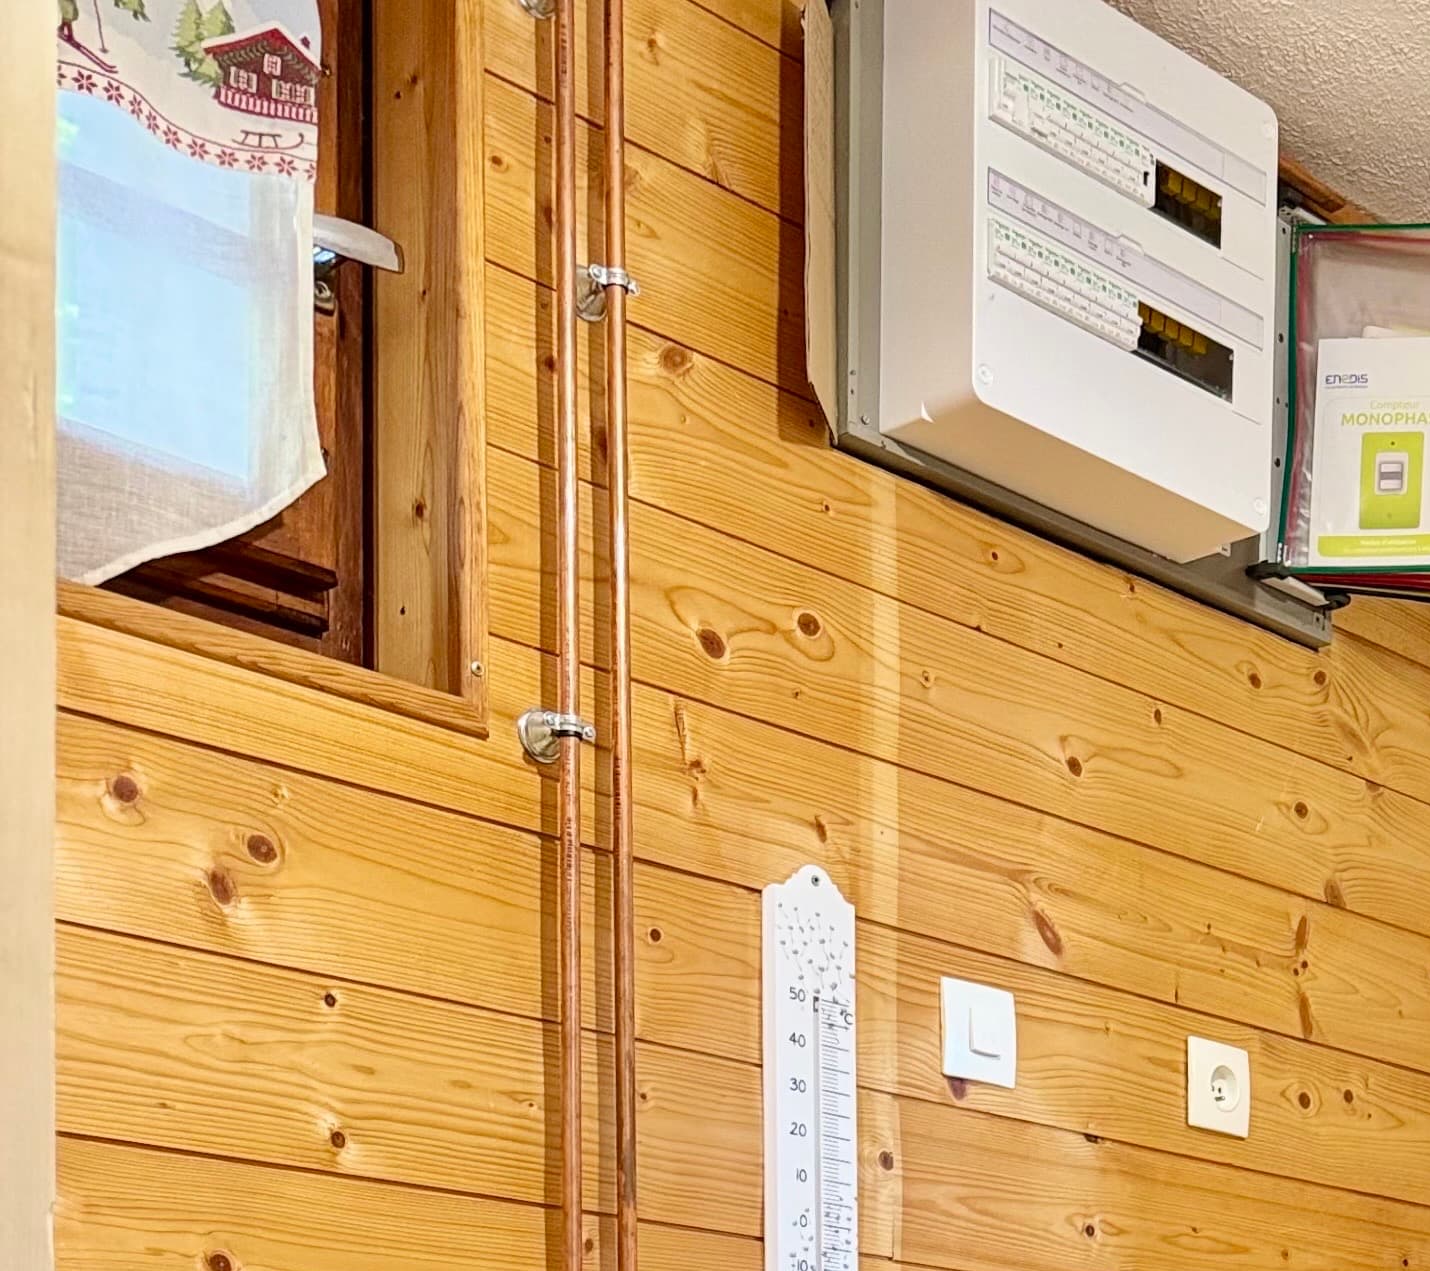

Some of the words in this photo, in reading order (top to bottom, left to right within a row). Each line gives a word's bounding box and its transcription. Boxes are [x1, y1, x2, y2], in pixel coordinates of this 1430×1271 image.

[789, 987, 806, 1002] 50
[789, 1034, 806, 1048] 40
[790, 1078, 807, 1093] 30
[790, 1123, 807, 1138] 20
[796, 1168, 807, 1182] 10
[800, 1214, 808, 1228] 0
